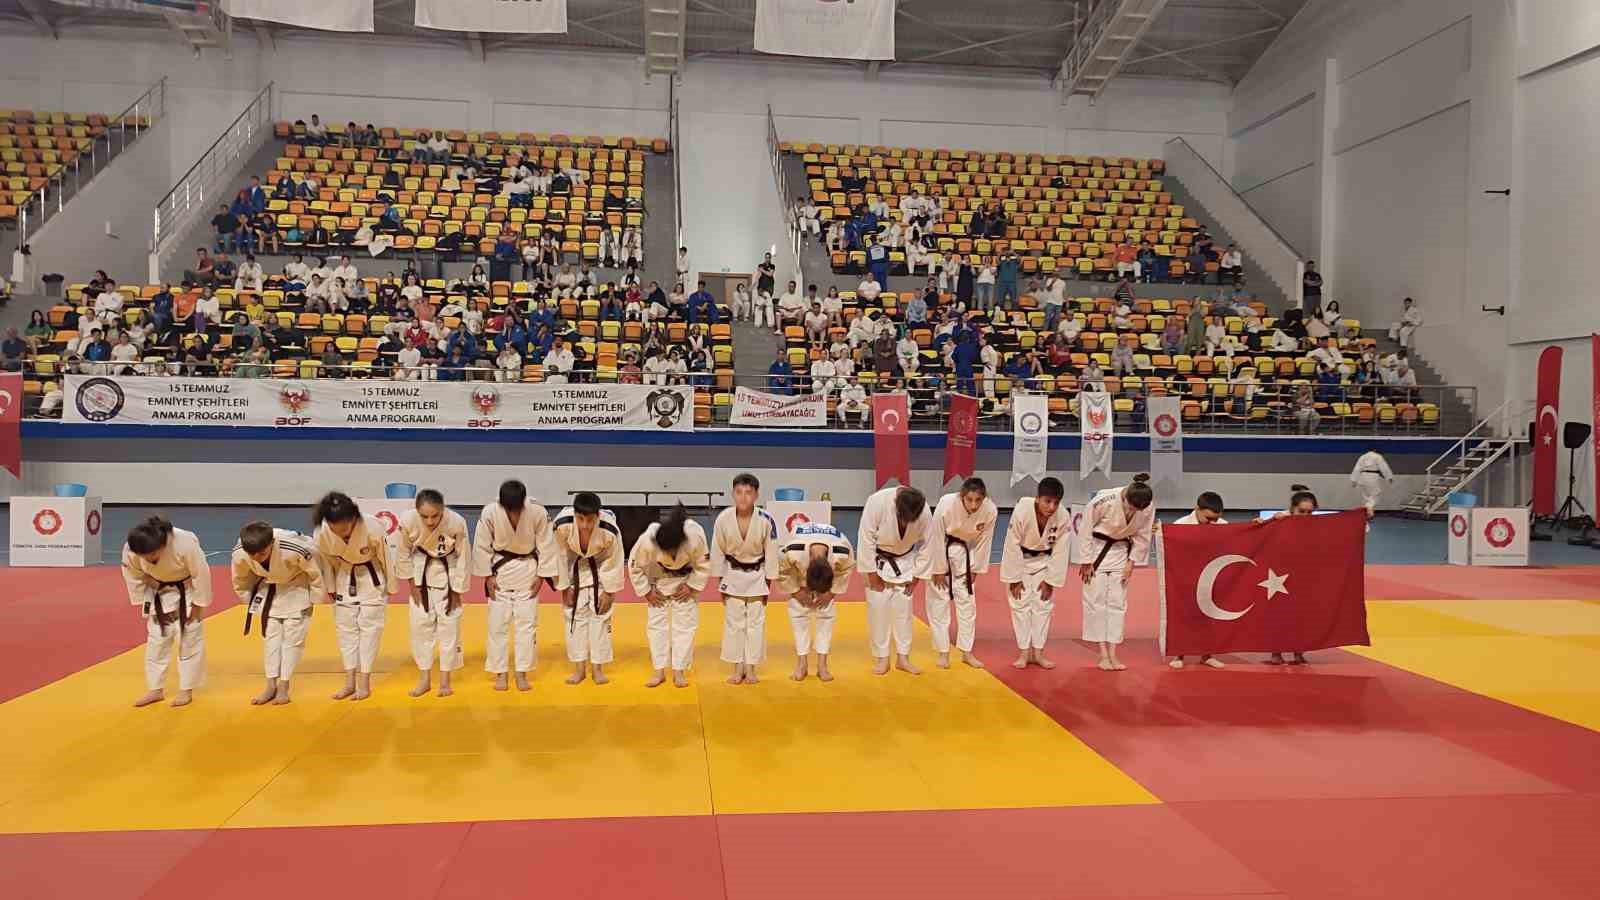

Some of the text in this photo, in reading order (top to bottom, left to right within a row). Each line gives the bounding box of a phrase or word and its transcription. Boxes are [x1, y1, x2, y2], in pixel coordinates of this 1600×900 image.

[169, 384, 230, 393] 15 TEMMUZ
[362, 387, 420, 397] 15 TEMMUZ
[552, 390, 608, 399] 15 TEMMUZ
[148, 396, 249, 408] EMNİYET ŞEHİTLERİ
[342, 399, 438, 411] EMNİYET ŞEHİTLERİ
[533, 402, 626, 414] EMNİYET ŞEHİTLERİ
[152, 411, 246, 421] ANMA PROGRAMI
[347, 414, 436, 423] ANMA PROGRAMI
[538, 415, 623, 425] ANMA PROGRAMI
